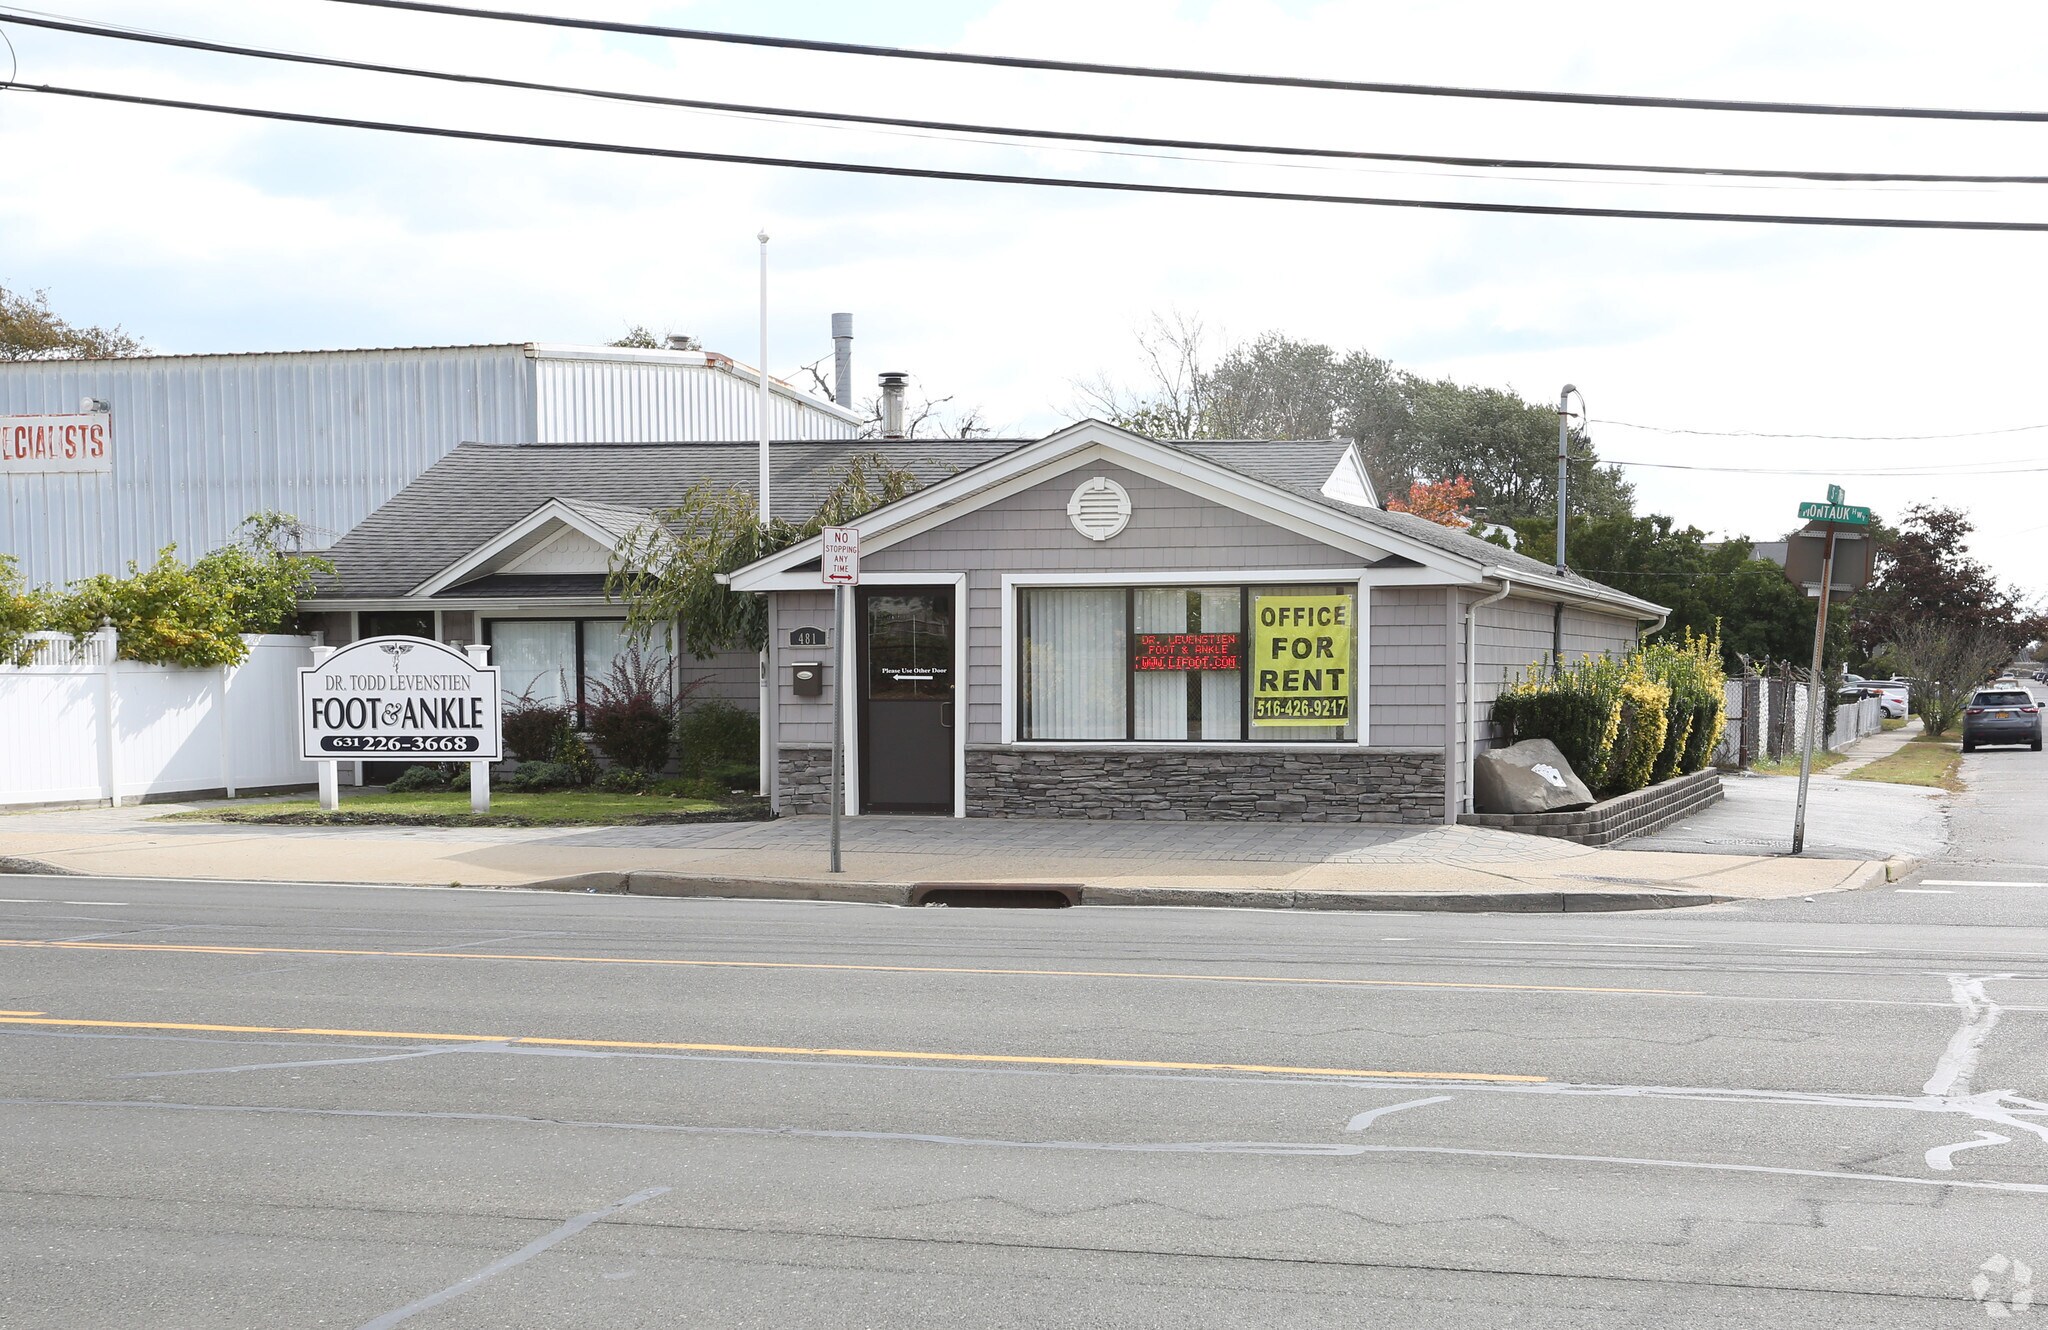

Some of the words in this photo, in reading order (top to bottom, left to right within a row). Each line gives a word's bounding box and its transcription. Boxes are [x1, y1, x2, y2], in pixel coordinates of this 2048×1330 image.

[0, 424, 104, 460] ECIALISTS
[1802, 504, 1851, 520] MONTAUK
[834, 532, 849, 543] NO
[825, 545, 857, 554] STOPPING
[834, 555, 848, 563] ANY
[833, 564, 849, 572] TIME
[1260, 606, 1346, 627] OFFICE
[798, 632, 816, 645] 481
[1141, 635, 1160, 645] DR.
[1148, 645, 1175, 655] FOOT
[1181, 645, 1189, 655] &
[1194, 644, 1228, 654] ANKLE
[1271, 636, 1334, 660] FOR
[325, 675, 347, 691] DR.
[350, 675, 386, 691] TODD
[389, 675, 471, 691] LEVENSTIEN
[1259, 668, 1345, 692] RENT
[312, 697, 381, 729] FOOT
[381, 703, 402, 725] &
[401, 697, 483, 729] ANKLE
[1257, 699, 1346, 717] 516-426-9217
[332, 737, 360, 748] 631
[362, 736, 468, 751] 226-3668
